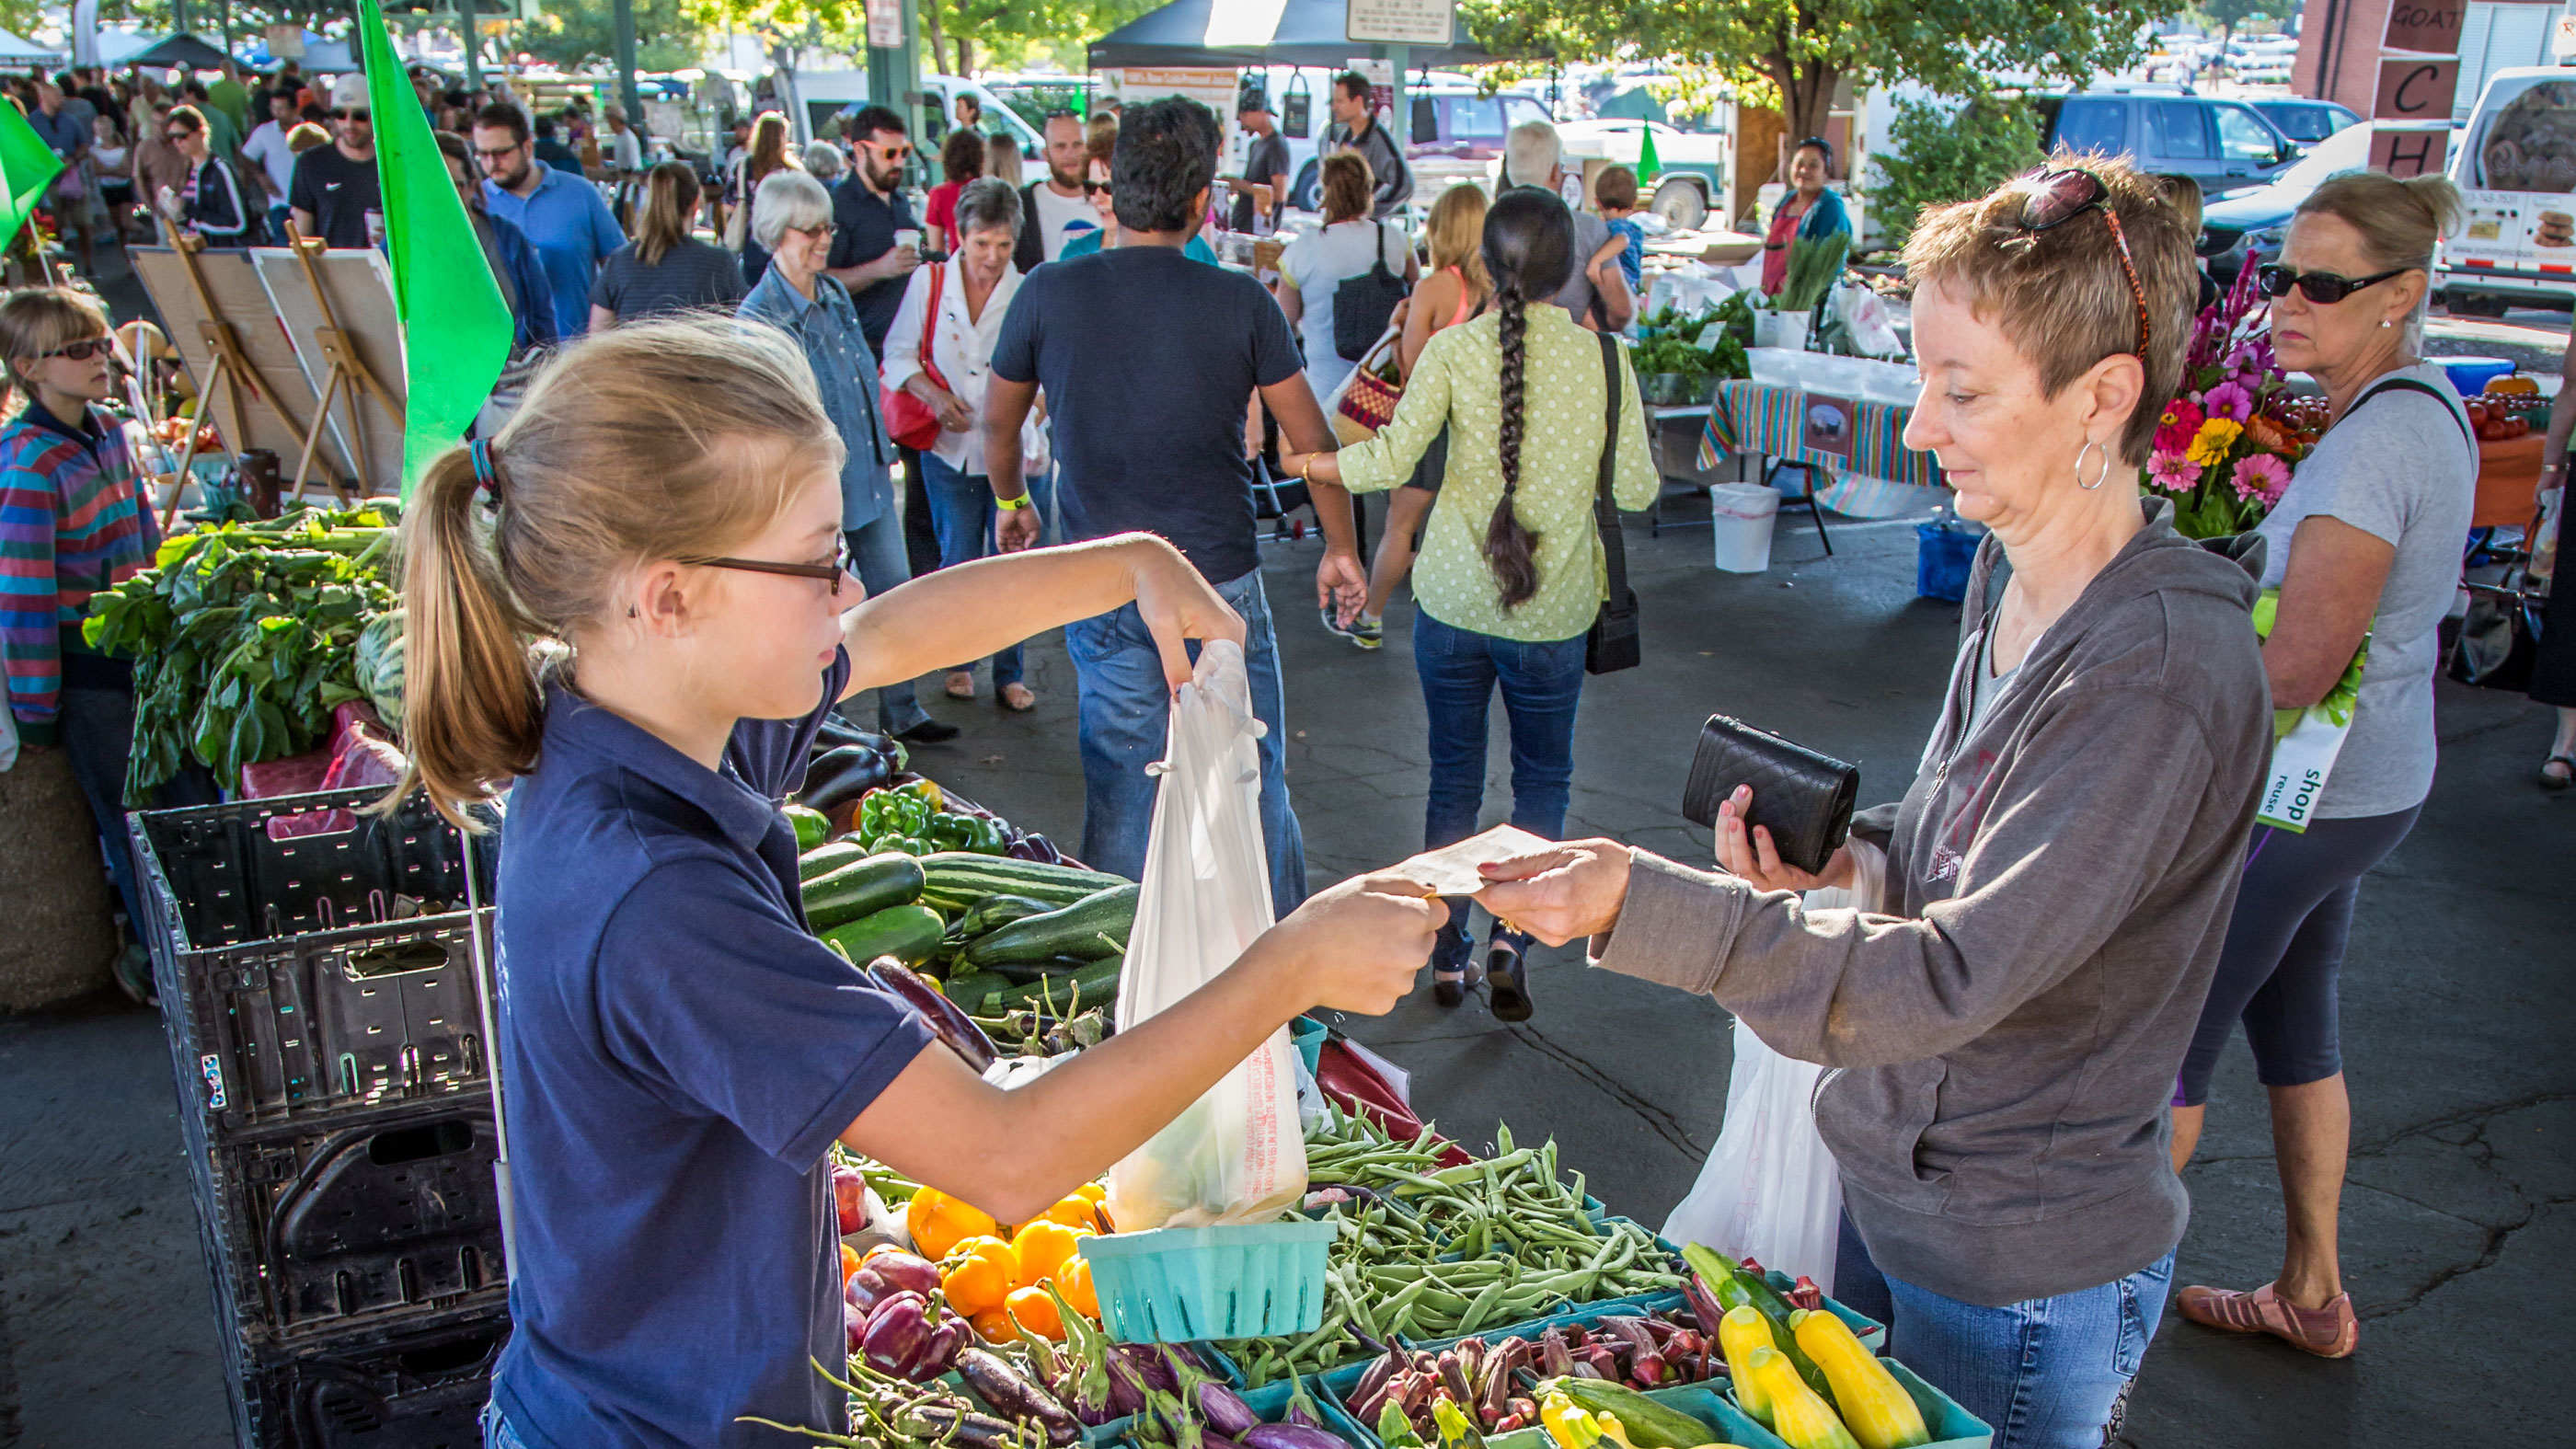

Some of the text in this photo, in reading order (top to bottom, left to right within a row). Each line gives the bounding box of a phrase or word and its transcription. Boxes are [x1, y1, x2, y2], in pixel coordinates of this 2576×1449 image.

[2394, 5, 2459, 29] GOAT
[2264, 775, 2288, 813] reuse
[2287, 769, 2321, 821] shop
